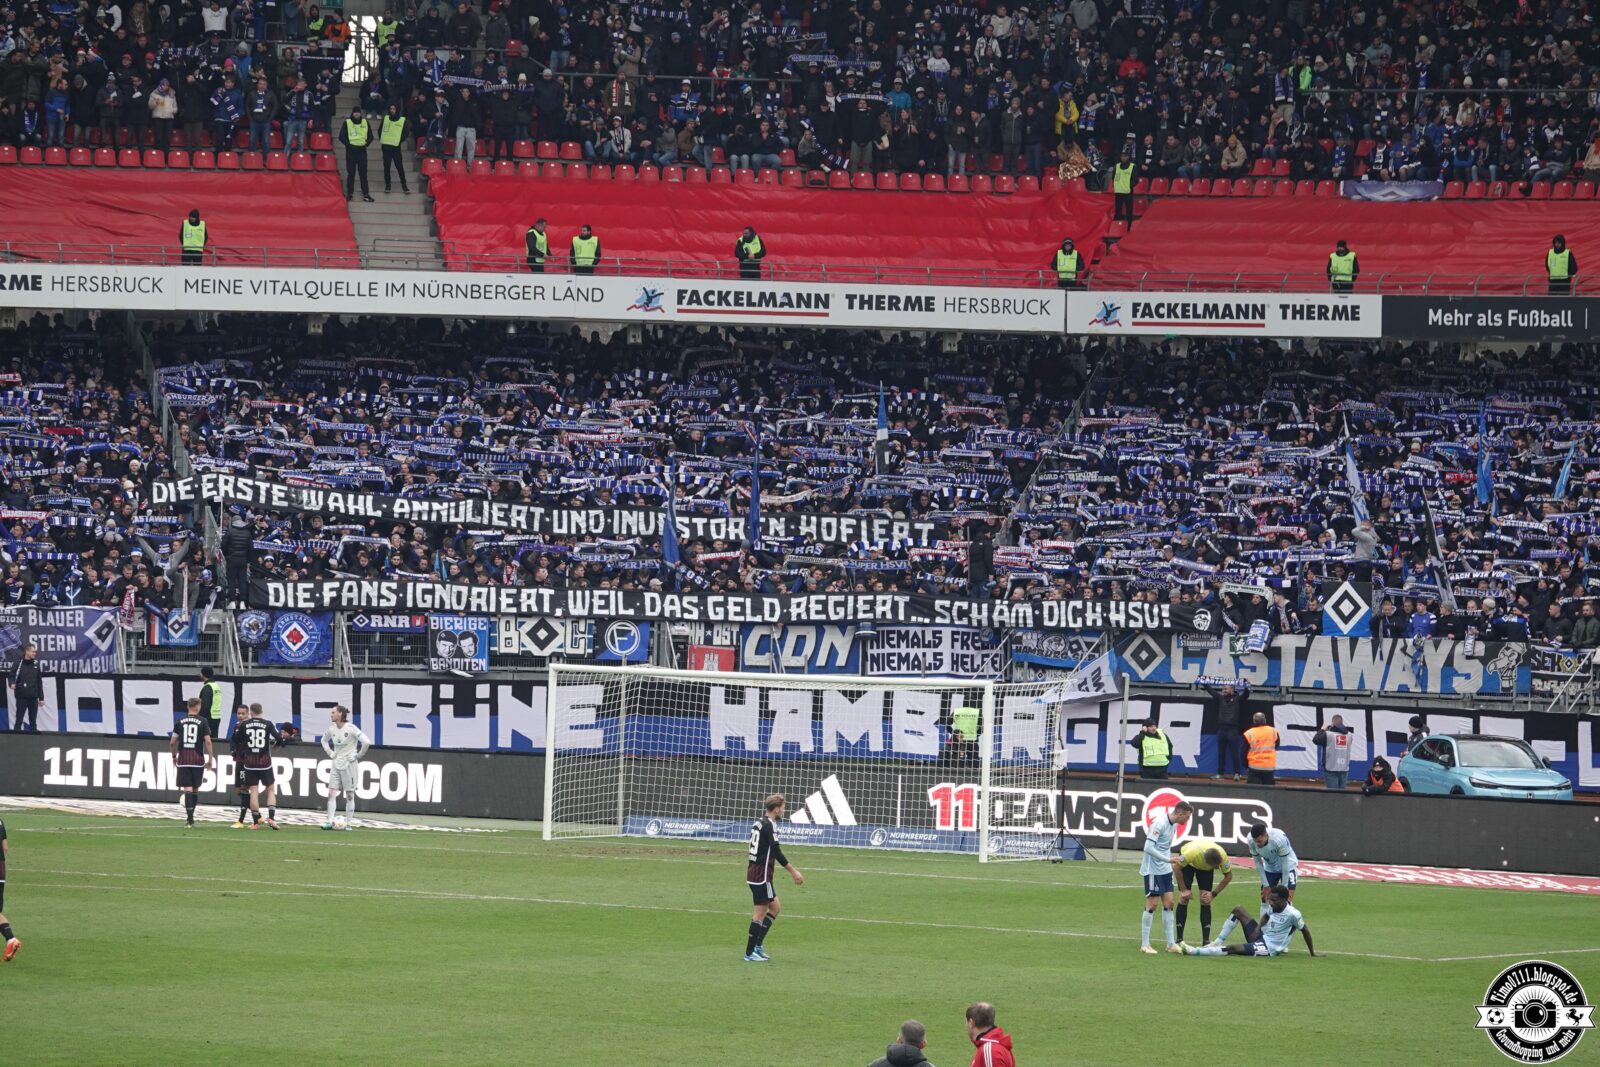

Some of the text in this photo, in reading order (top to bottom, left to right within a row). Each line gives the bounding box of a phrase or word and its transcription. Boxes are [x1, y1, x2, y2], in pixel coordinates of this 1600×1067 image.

[51, 274, 164, 295] HERSBRUCK
[183, 277, 604, 302] MEINE VITALQUELLE IM NÜRNBERGER LAND
[676, 289, 1051, 316] FACKELMANN THERME HERSBRUCK
[1132, 301, 1361, 321] FACKELMANN THERME
[1427, 308, 1574, 328] Mehr als Fußball
[15, 466, 73, 478] HAMBRG
[152, 477, 195, 504] DIE
[200, 473, 289, 507] ERSTE
[301, 489, 382, 518] WAHL
[392, 499, 544, 531] ANNULIERT
[551, 508, 604, 534] UND
[798, 515, 935, 546] HOFIERT
[266, 582, 315, 608] DIE
[318, 580, 398, 607] FANS
[568, 588, 634, 616] WEIL
[644, 592, 700, 620] DAS
[706, 595, 780, 622] GELD
[934, 600, 1033, 627] SCHÄM
[1042, 600, 1102, 628] DICH
[28, 609, 85, 627] BLAUER
[430, 616, 487, 630] BIERIGE
[28, 634, 76, 652] STERN
[430, 658, 487, 671] BANDITEN
[869, 652, 944, 673] NIEMALS
[1169, 634, 1485, 693] CASTAWAYS
[183, 723, 199, 743] 19
[245, 728, 266, 748] 38
[44, 746, 443, 803] 11TEAMPRTS.COM
